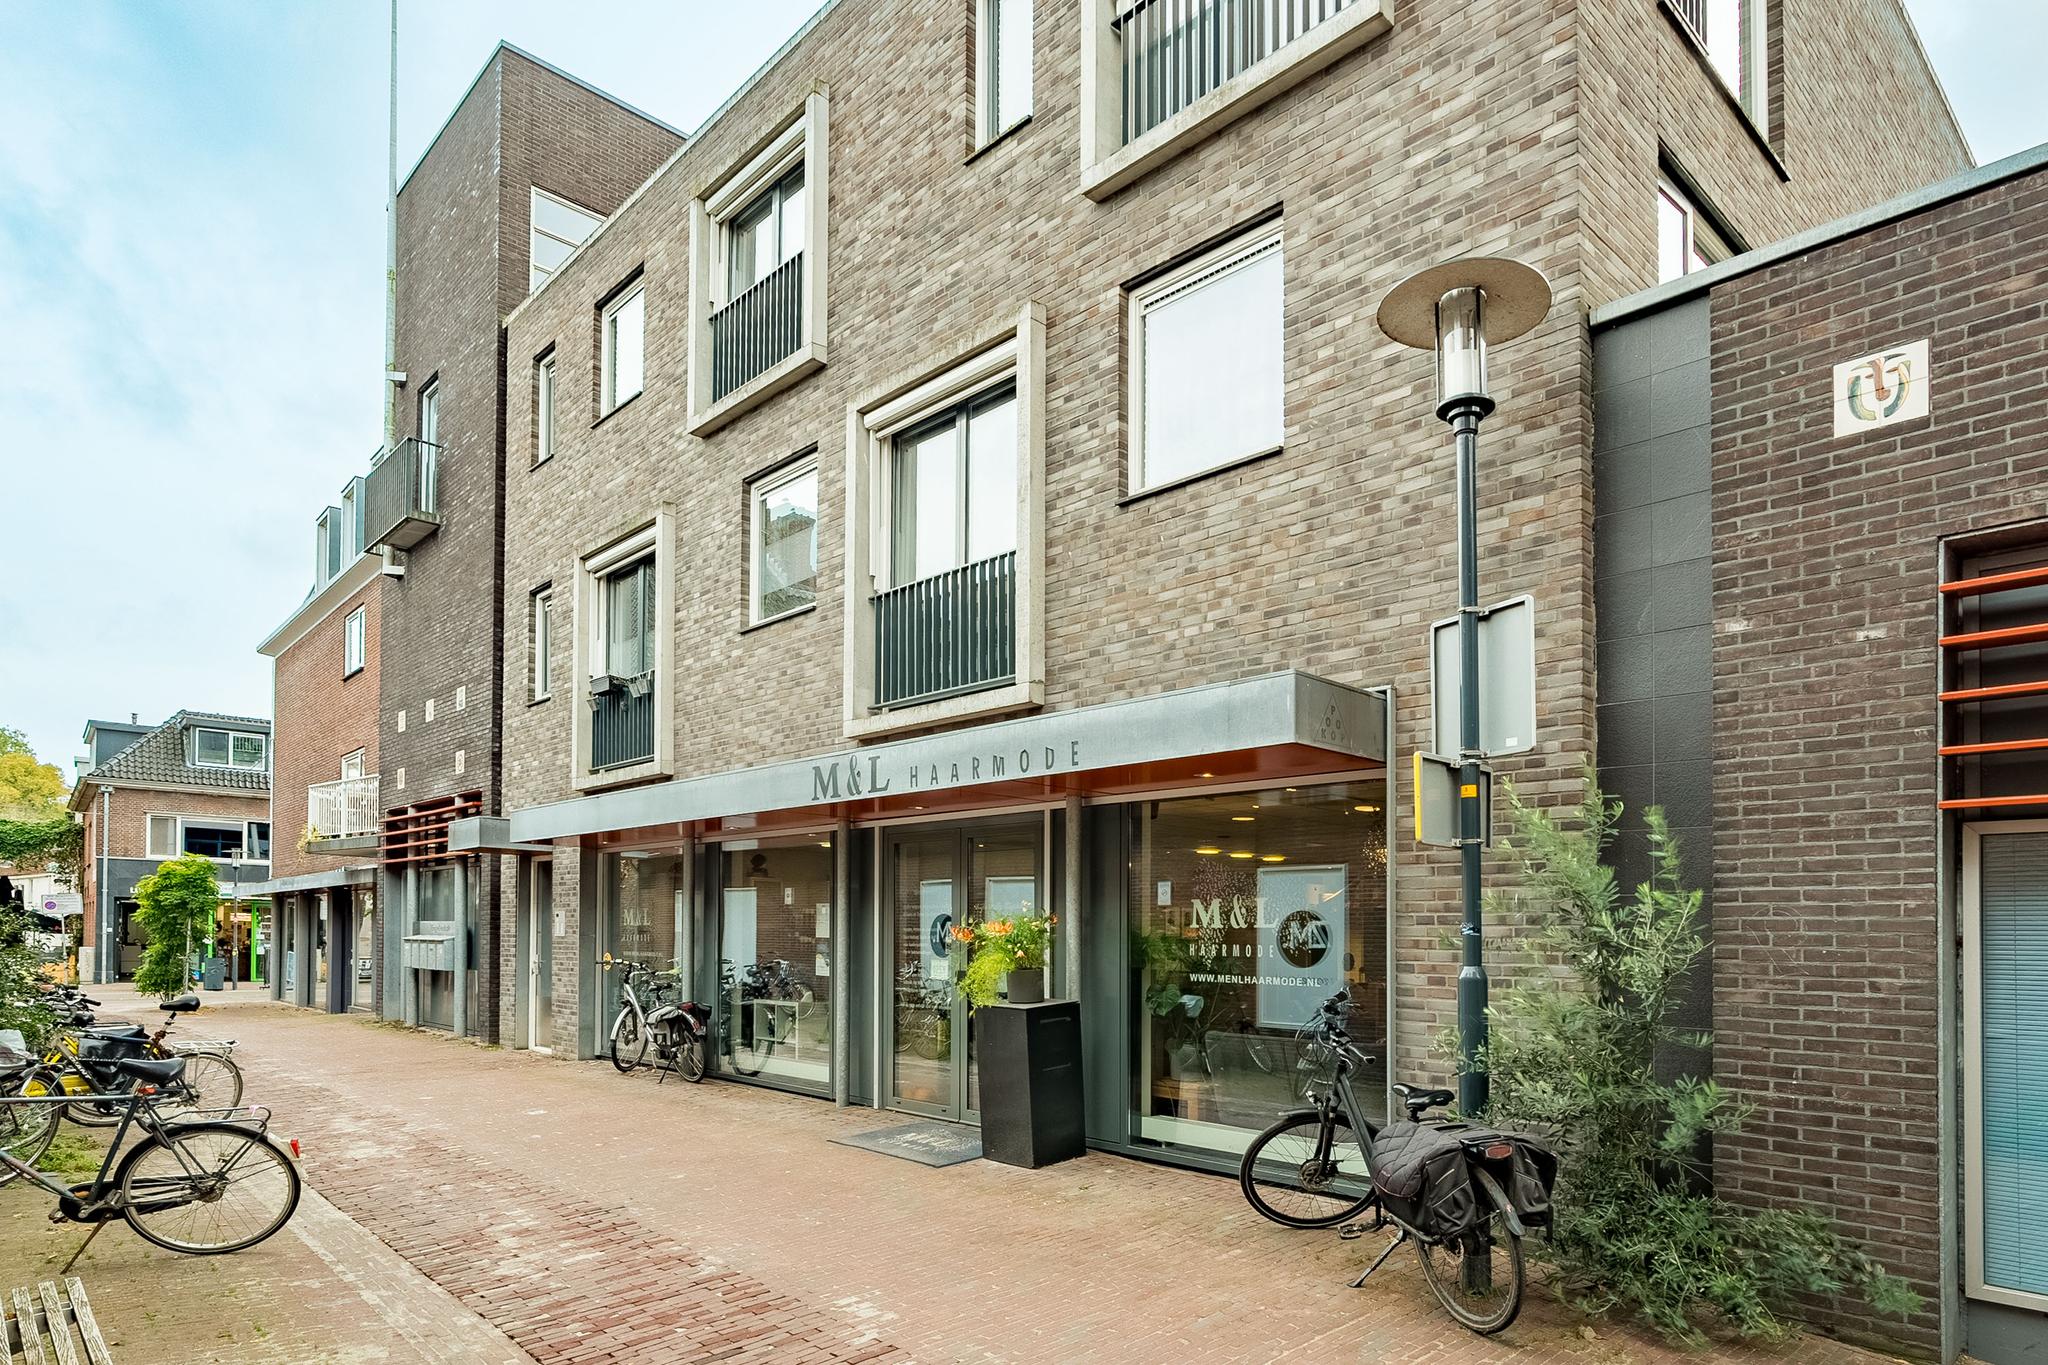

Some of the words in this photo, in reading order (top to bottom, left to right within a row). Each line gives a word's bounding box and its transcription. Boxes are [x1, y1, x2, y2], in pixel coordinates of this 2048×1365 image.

[811, 755, 890, 801] M&L
[909, 740, 1080, 788] HAARMODE
[1189, 942, 1275, 959] HAARMODE
[1189, 973, 1322, 988] WWW.MENLHAARMODE.NL
